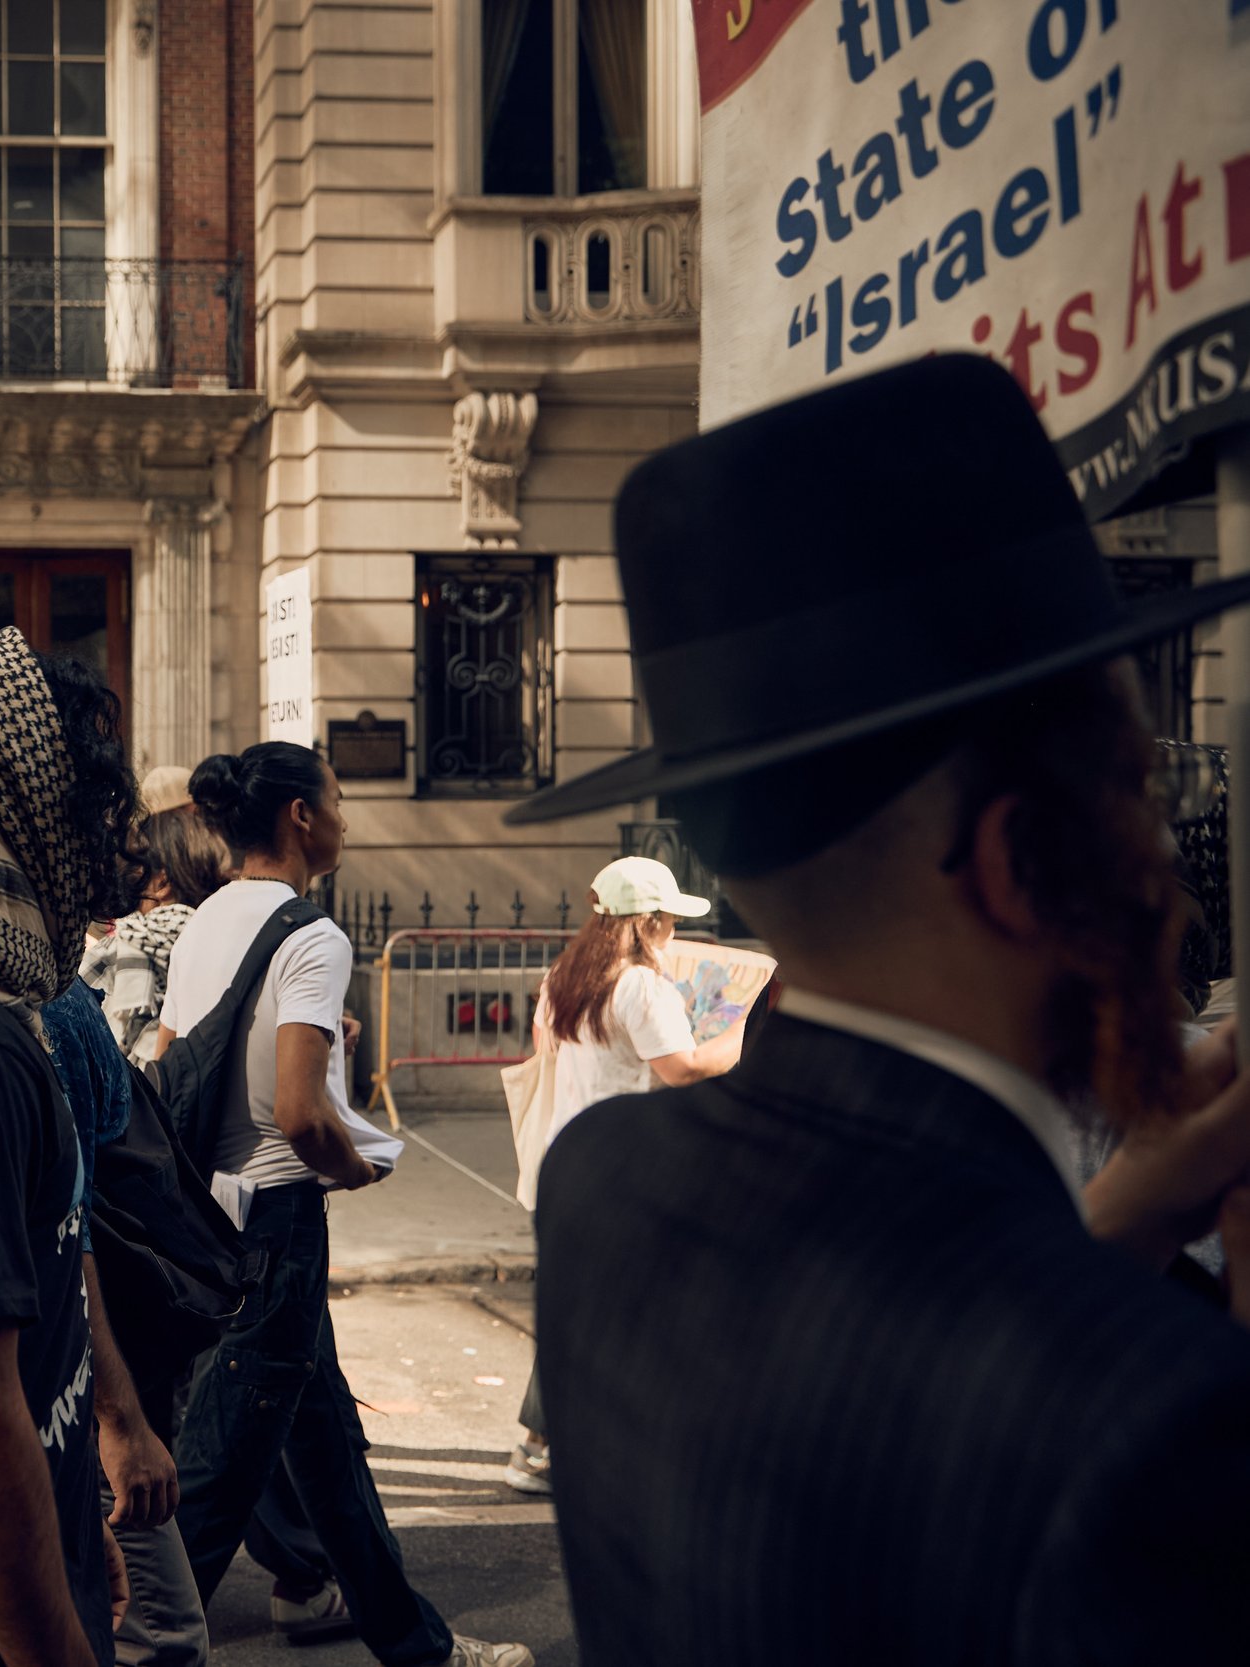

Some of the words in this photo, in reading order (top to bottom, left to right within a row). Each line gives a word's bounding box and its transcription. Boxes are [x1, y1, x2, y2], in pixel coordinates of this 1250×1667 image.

[837, 0, 966, 84] th
[775, 59, 996, 278] State
[787, 63, 1122, 376] “Israel”
[1125, 153, 1250, 352] At
